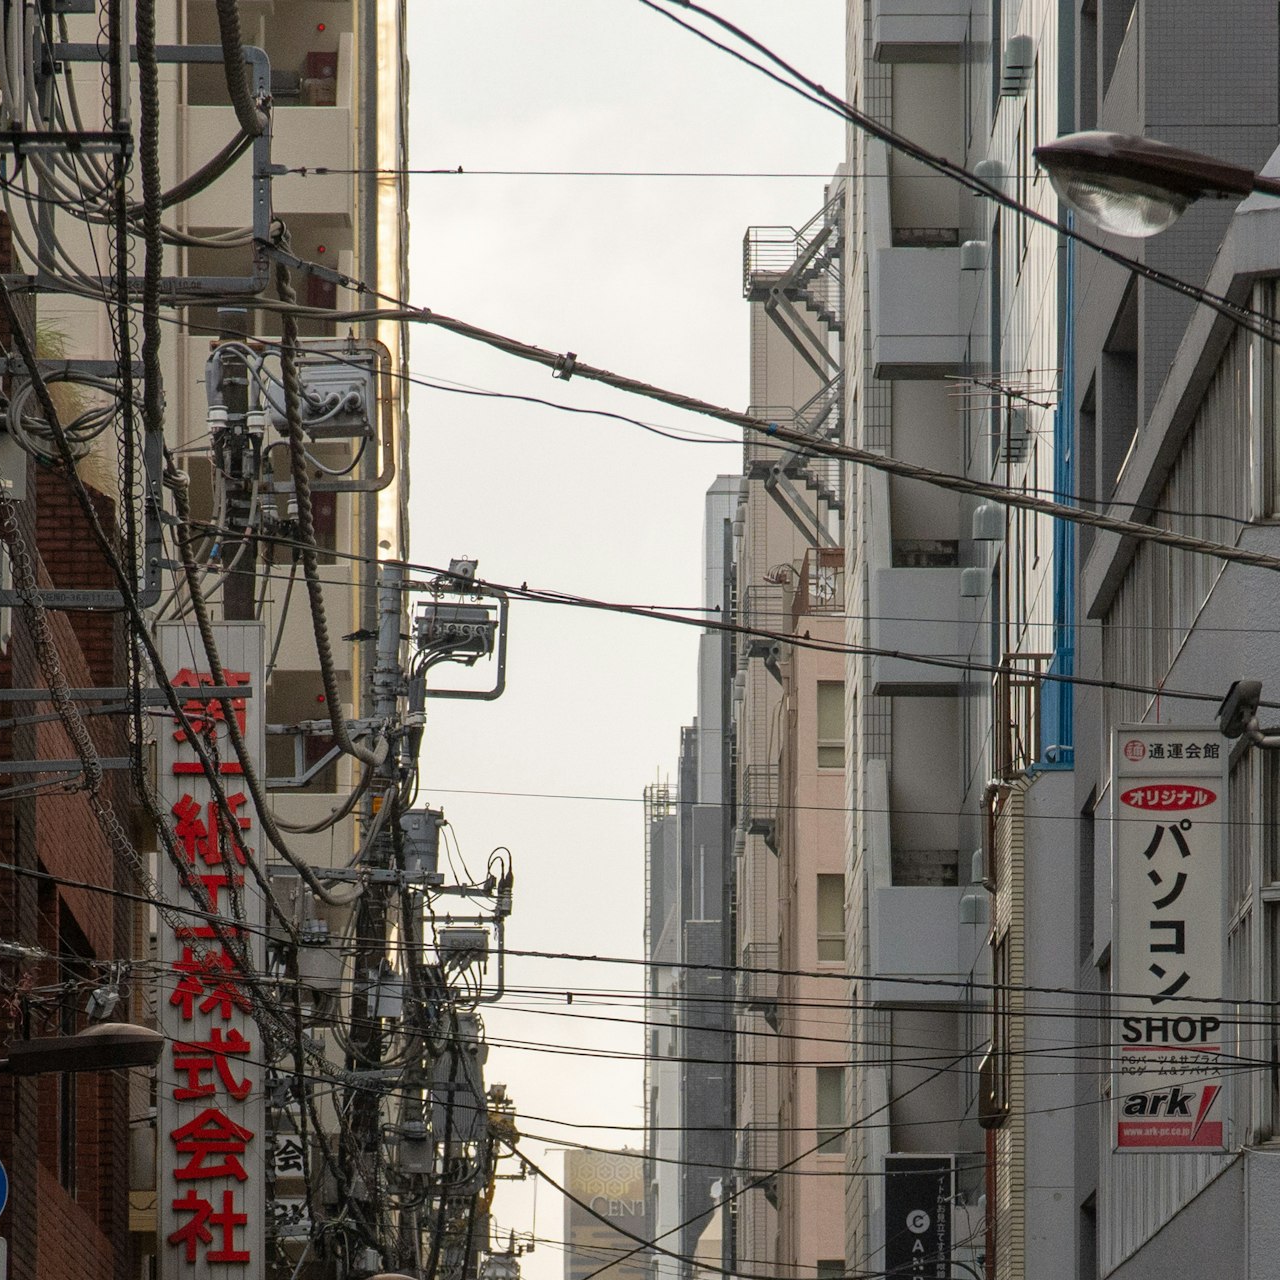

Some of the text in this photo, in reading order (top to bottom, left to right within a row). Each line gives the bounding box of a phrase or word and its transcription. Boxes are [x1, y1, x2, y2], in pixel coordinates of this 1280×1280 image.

[1148, 743, 1220, 759] 通運会館
[1129, 790, 1208, 806] オリジナル
[1143, 818, 1192, 1005] パソコン
[1122, 1016, 1220, 1043] SHOP
[1124, 1087, 1194, 1117] ark
